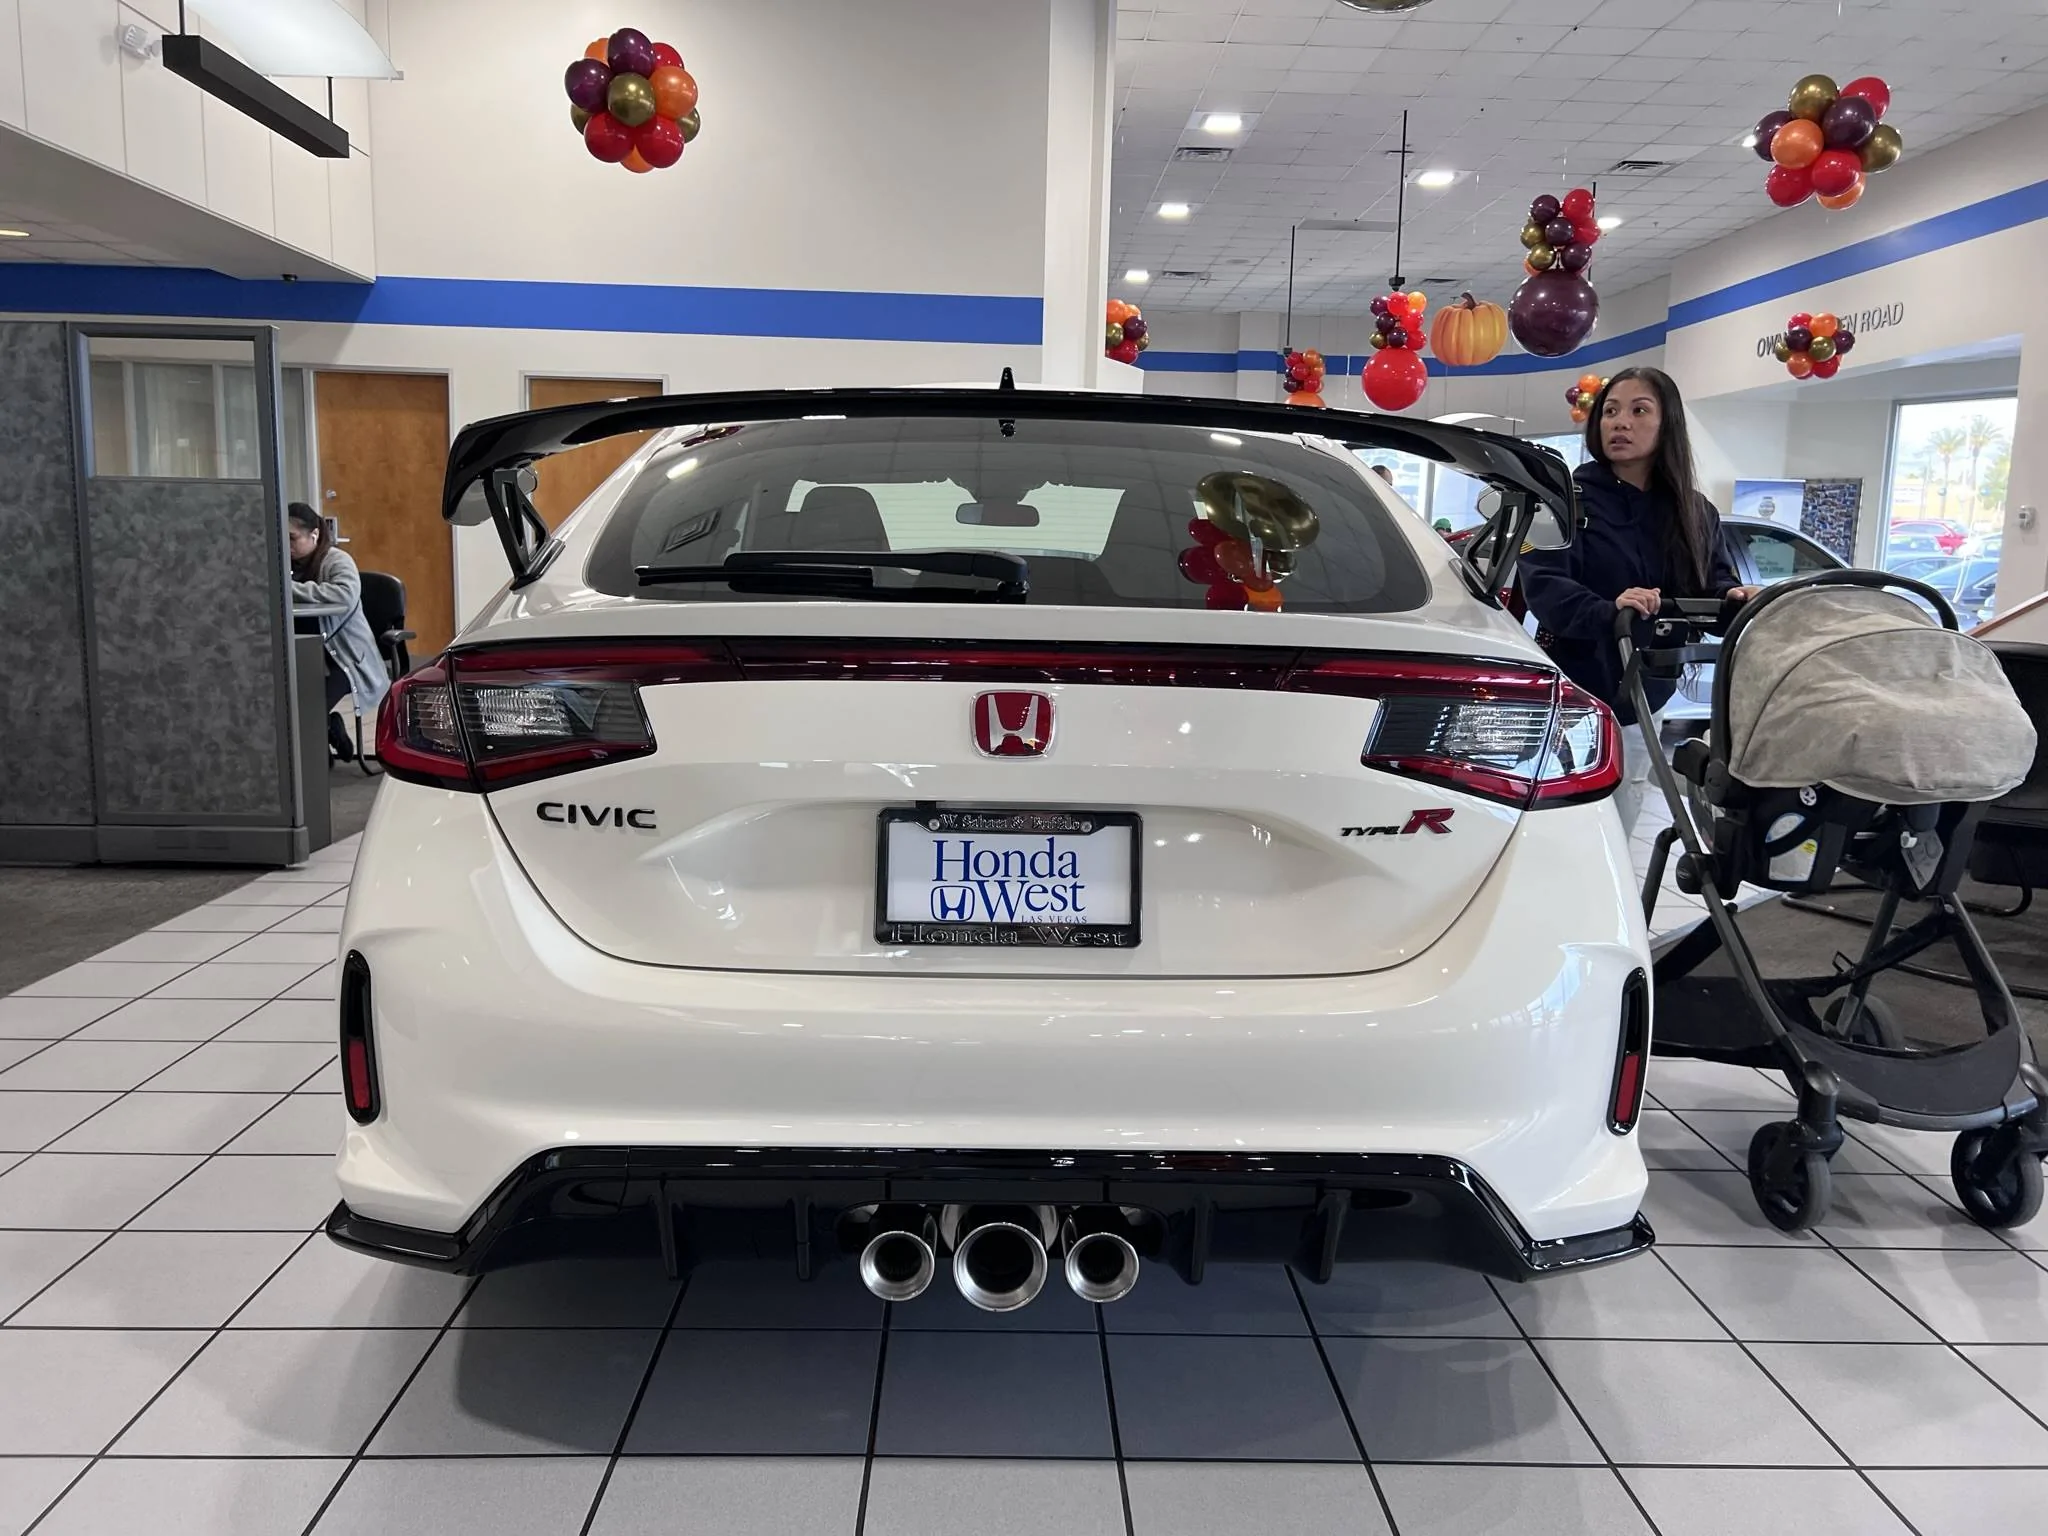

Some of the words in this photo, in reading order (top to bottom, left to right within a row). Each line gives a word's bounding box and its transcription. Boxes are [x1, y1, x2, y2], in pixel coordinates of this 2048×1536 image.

[1860, 301, 1904, 334] ROAD
[536, 801, 657, 829] CIVIC
[962, 813, 1007, 829] Sahara
[1010, 816, 1025, 830] &
[1030, 814, 1081, 831] Buffalo
[1341, 825, 1400, 836] TYPE
[1400, 807, 1455, 834] R
[932, 837, 1080, 882] Honda
[976, 879, 1085, 923] West
[1021, 915, 1043, 924] LAS
[1048, 915, 1088, 924] VEGAS
[889, 923, 1019, 945] Honda
[1029, 925, 1129, 946] West
